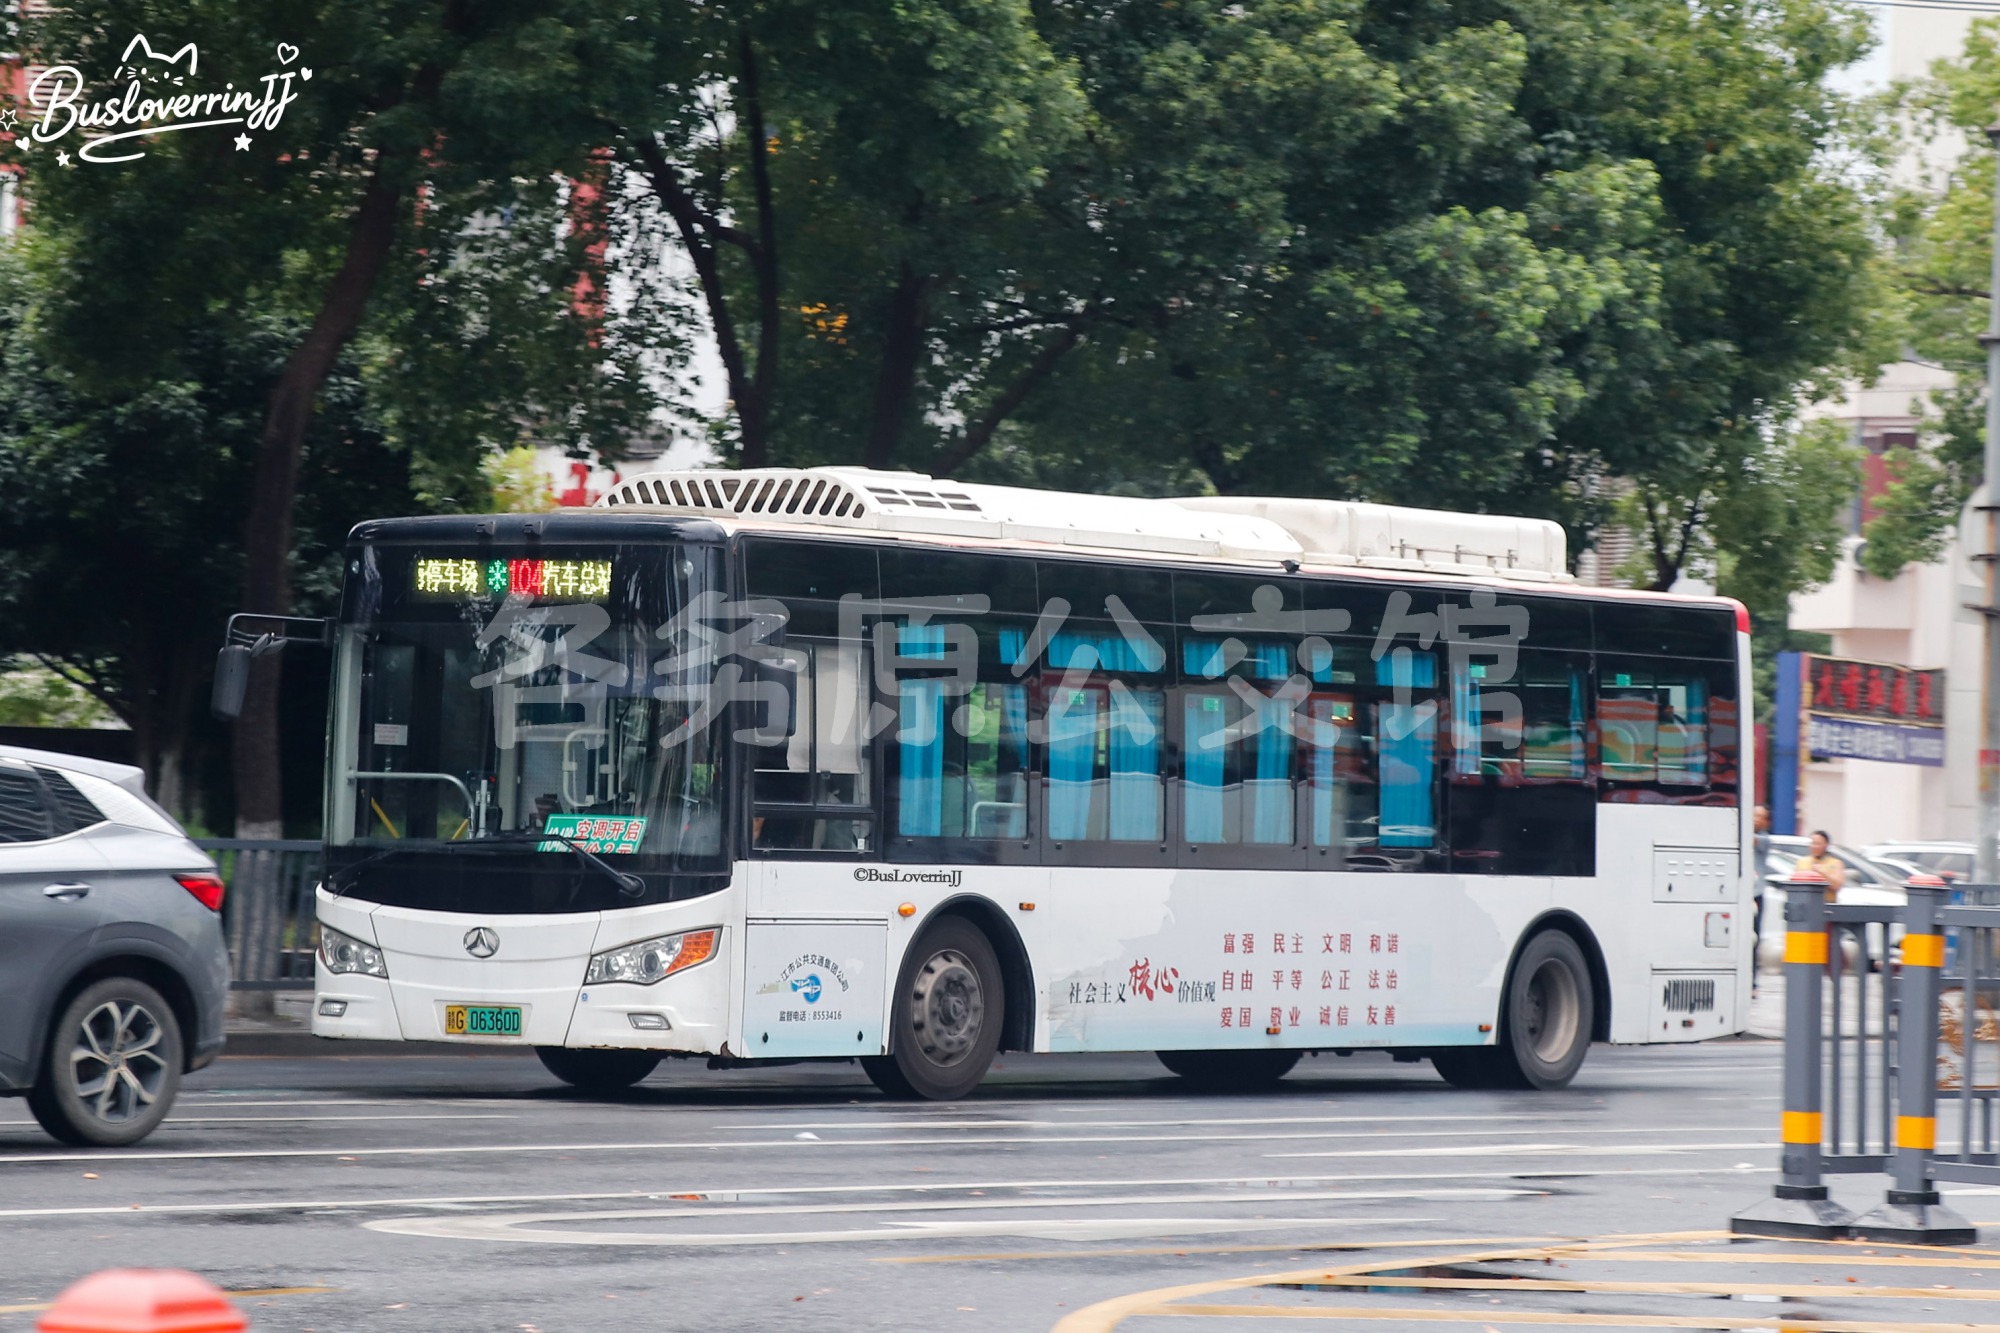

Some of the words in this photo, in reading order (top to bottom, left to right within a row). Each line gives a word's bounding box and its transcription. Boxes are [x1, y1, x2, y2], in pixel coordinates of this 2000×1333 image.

[509, 560, 543, 594] 104
[574, 819, 642, 841] 空调开启
[1223, 933, 1255, 954] 富强
[1273, 933, 1304, 953] 民主
[1322, 933, 1352, 953] 文明
[1369, 933, 1400, 953] 和谐
[776, 954, 849, 993] 江市公共交通集团公司
[1068, 957, 1216, 1004] 社会主义核心价值观
[1222, 969, 1253, 992] 自由
[1271, 969, 1303, 991] 平等
[1320, 969, 1351, 991] 公正
[1368, 969, 1398, 990] 法治
[1220, 1006, 1251, 1028] 爱国
[1270, 1006, 1301, 1027] 敬业
[1319, 1005, 1349, 1026] 诚信
[1366, 1004, 1396, 1025] 友善
